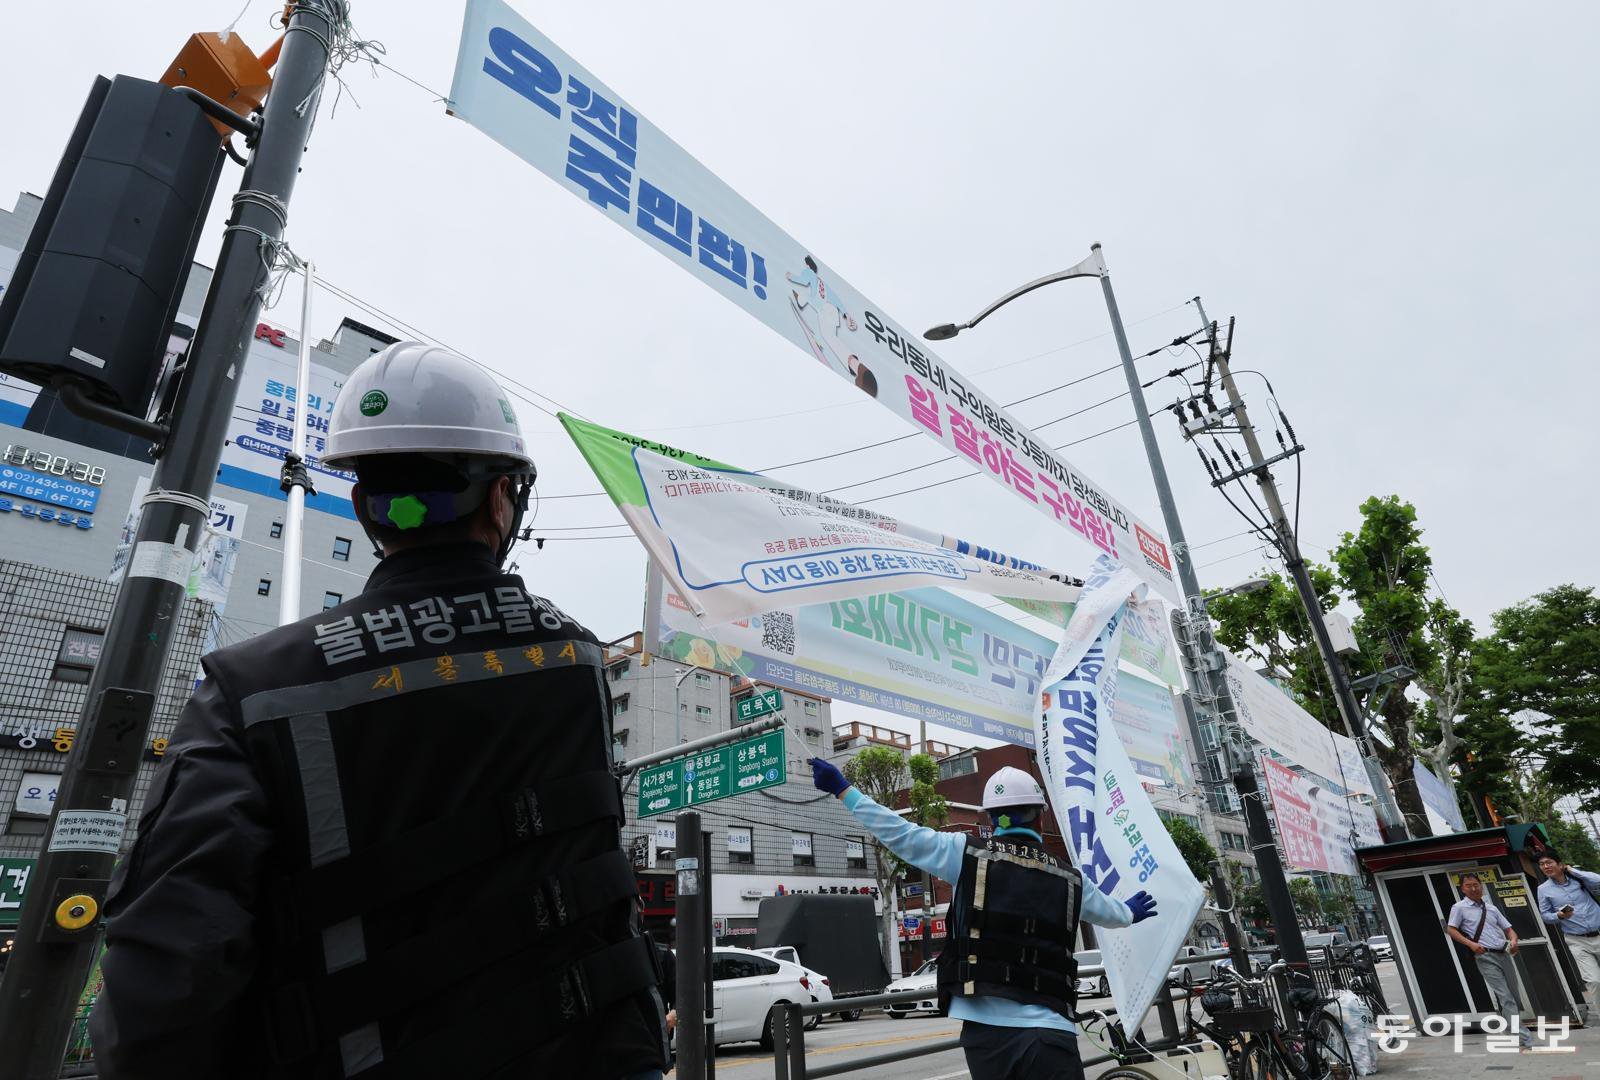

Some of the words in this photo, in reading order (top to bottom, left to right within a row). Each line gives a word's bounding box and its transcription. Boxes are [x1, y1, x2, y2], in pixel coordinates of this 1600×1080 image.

[483, 26, 638, 170] 오직
[566, 134, 768, 301] 주민편!
[864, 310, 948, 396] 우리동네
[948, 374, 1017, 450] 구의원은
[1017, 430, 1072, 482] 3등까지
[1069, 471, 1130, 535] 당선됩니다
[904, 374, 943, 438] 일
[945, 403, 1038, 504] 잘하는
[1037, 471, 1120, 561] 구의원!
[763, 563, 806, 586] DAY
[806, 560, 840, 578] 이용
[839, 556, 874, 575] 자유
[741, 694, 777, 717] 면목역
[737, 742, 767, 762] 상봉역
[642, 769, 674, 788] 사가정역
[697, 775, 720, 791] 동일로
[1122, 823, 1144, 849] 우리
[1129, 843, 1159, 883] 중랑
